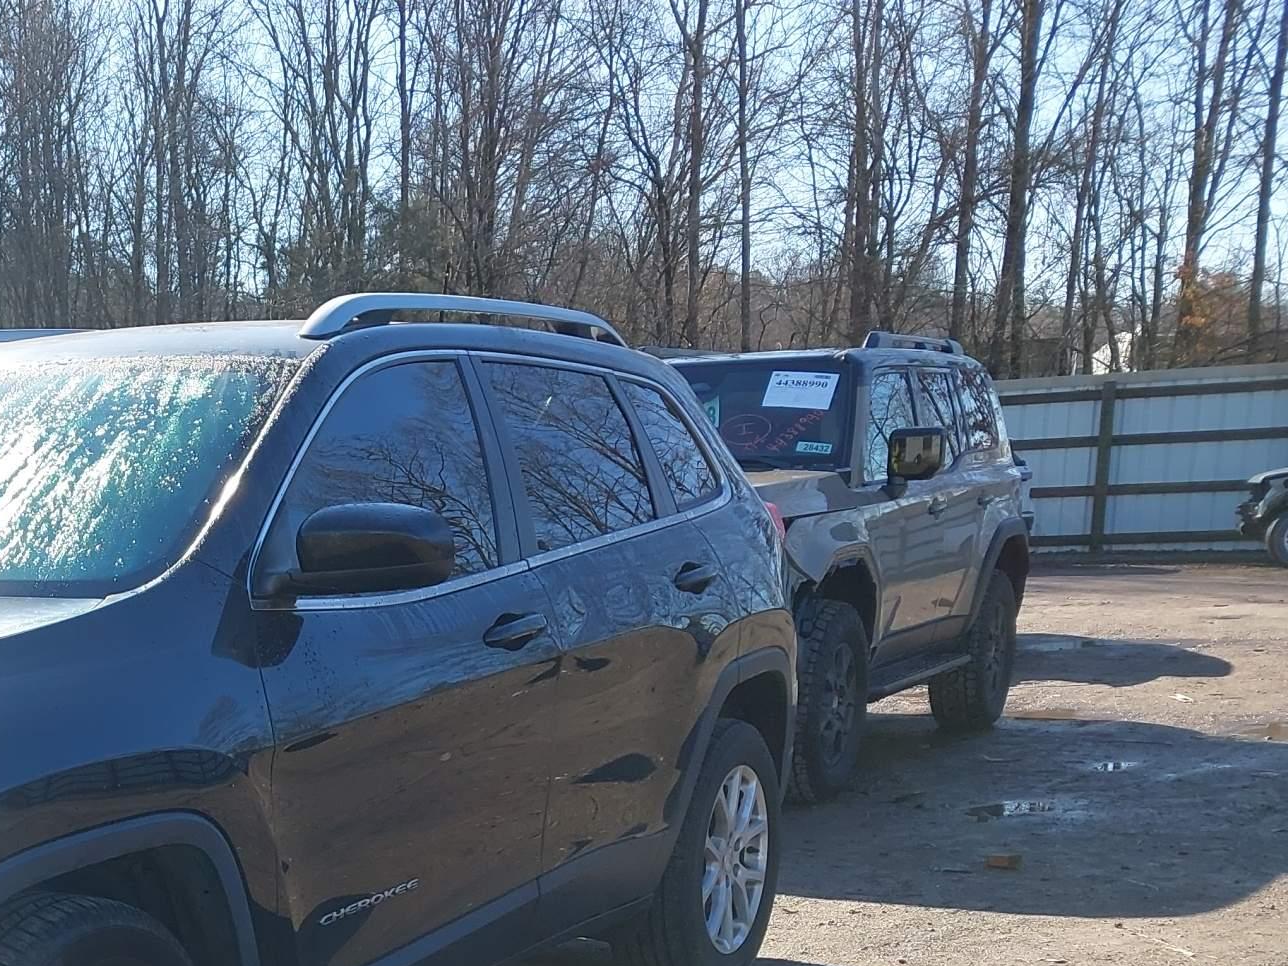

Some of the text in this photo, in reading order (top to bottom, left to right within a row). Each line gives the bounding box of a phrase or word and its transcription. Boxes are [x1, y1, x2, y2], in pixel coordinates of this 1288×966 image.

[775, 379, 828, 389] 44388990
[803, 443, 830, 453] 28432
[319, 878, 420, 926] CHEROKEE
